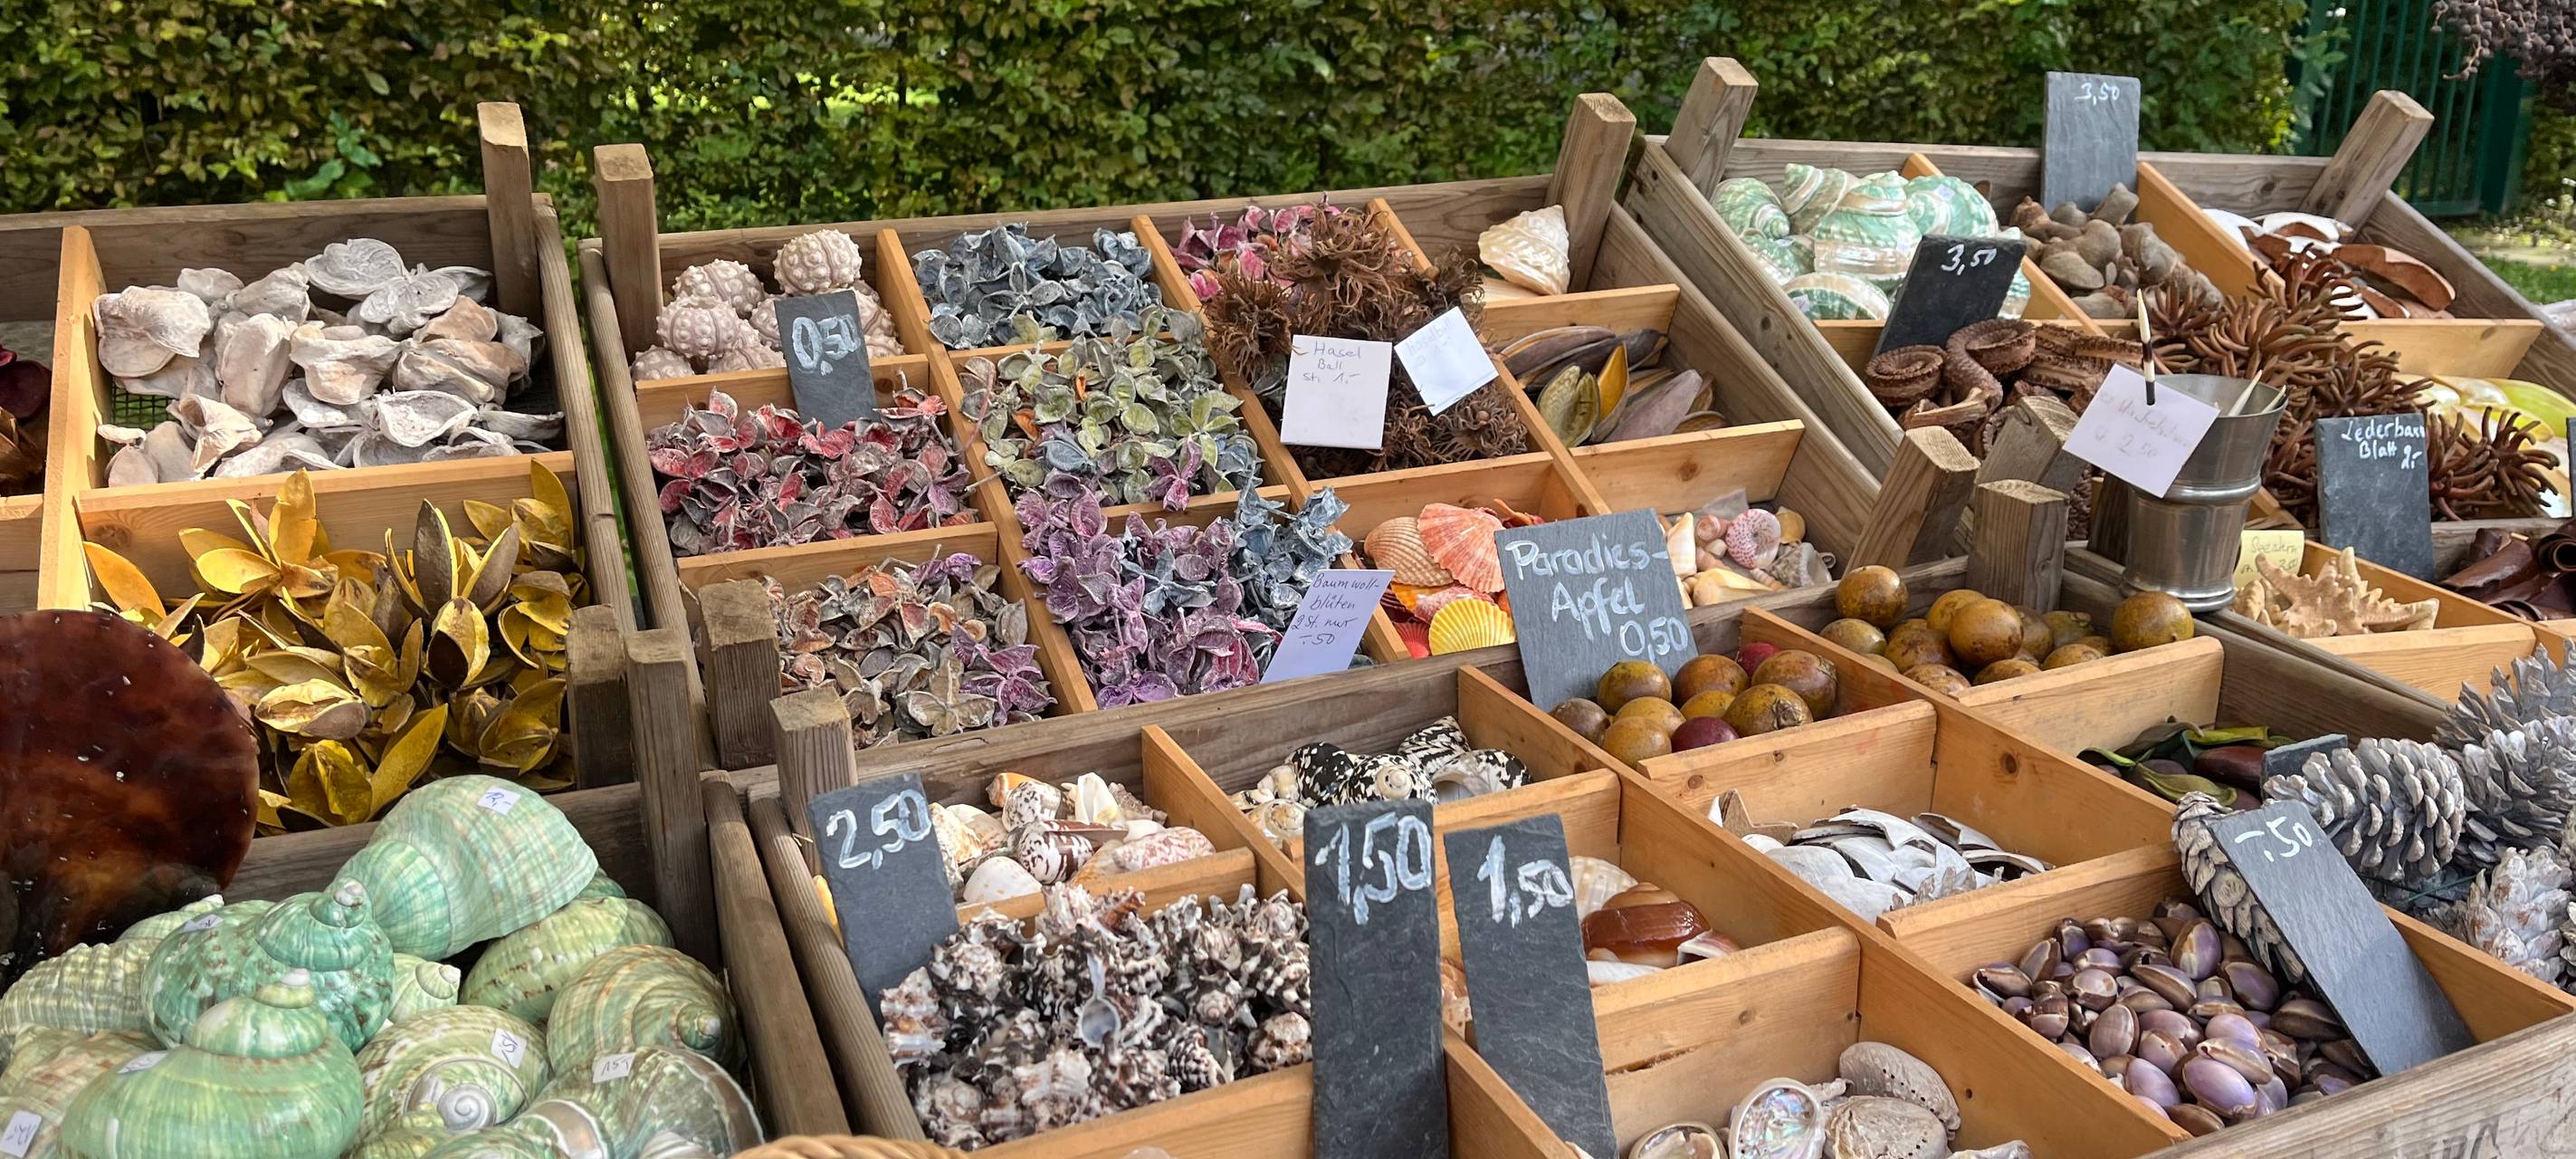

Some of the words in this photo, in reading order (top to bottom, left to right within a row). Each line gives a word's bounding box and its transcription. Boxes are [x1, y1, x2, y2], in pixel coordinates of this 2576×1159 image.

[2075, 82, 2120, 105] 3,50
[1942, 244, 1997, 275] 3,50
[792, 314, 861, 376] 0,50
[1313, 340, 1361, 359] Hasel
[1318, 359, 1342, 369] Ball
[2359, 439, 2397, 460] Blatt
[1505, 532, 1668, 580] Paradies-
[1310, 593, 1355, 610] blüten
[1551, 576, 1646, 641] Apfel
[1325, 618, 1359, 628] nur
[1620, 616, 1689, 664] 0,50
[826, 789, 932, 870] 2,50
[1314, 811, 1433, 925] 1,50
[1476, 833, 1574, 929] 1,50
